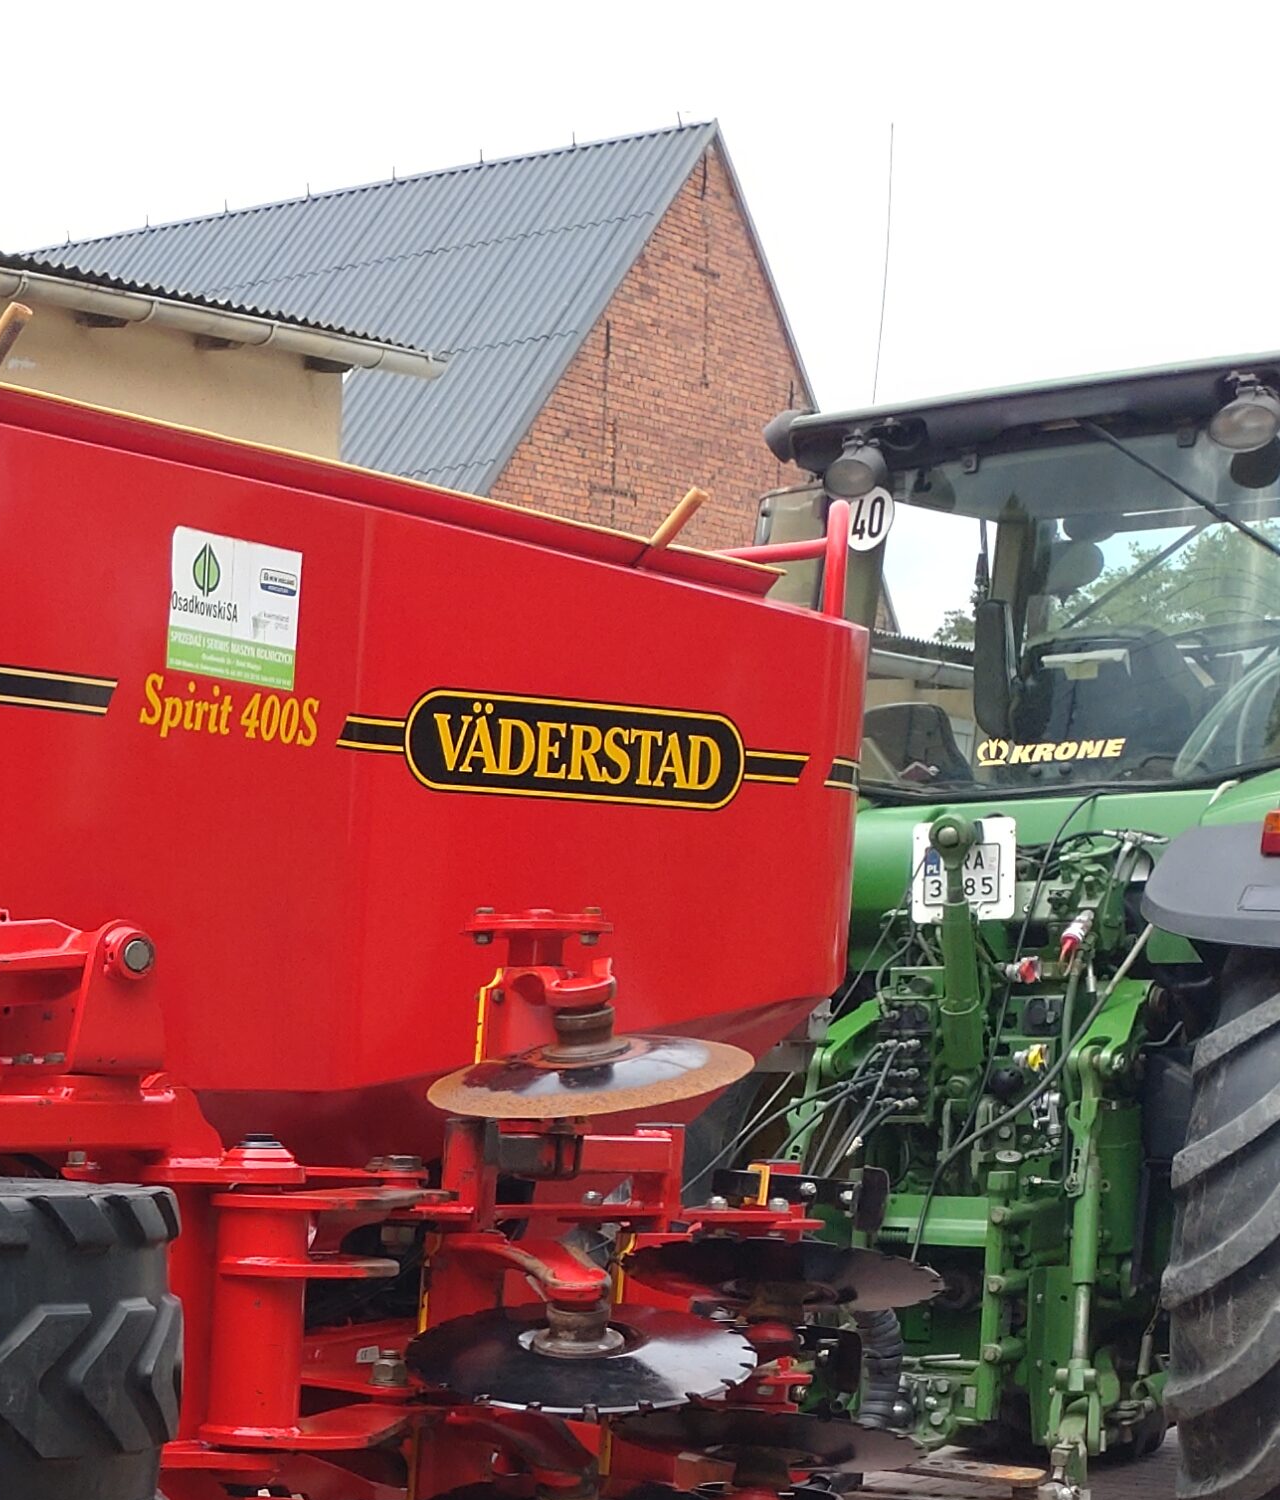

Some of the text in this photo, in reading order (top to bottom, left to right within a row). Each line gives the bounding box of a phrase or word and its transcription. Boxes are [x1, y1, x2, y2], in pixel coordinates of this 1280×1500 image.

[852, 496, 885, 540] 40
[139, 673, 320, 747] Spirit 400S
[433, 702, 722, 790] VÄDERSTAD
[1009, 738, 1126, 764] KRONE
[926, 864, 939, 874] PL
[930, 876, 993, 898] 385
